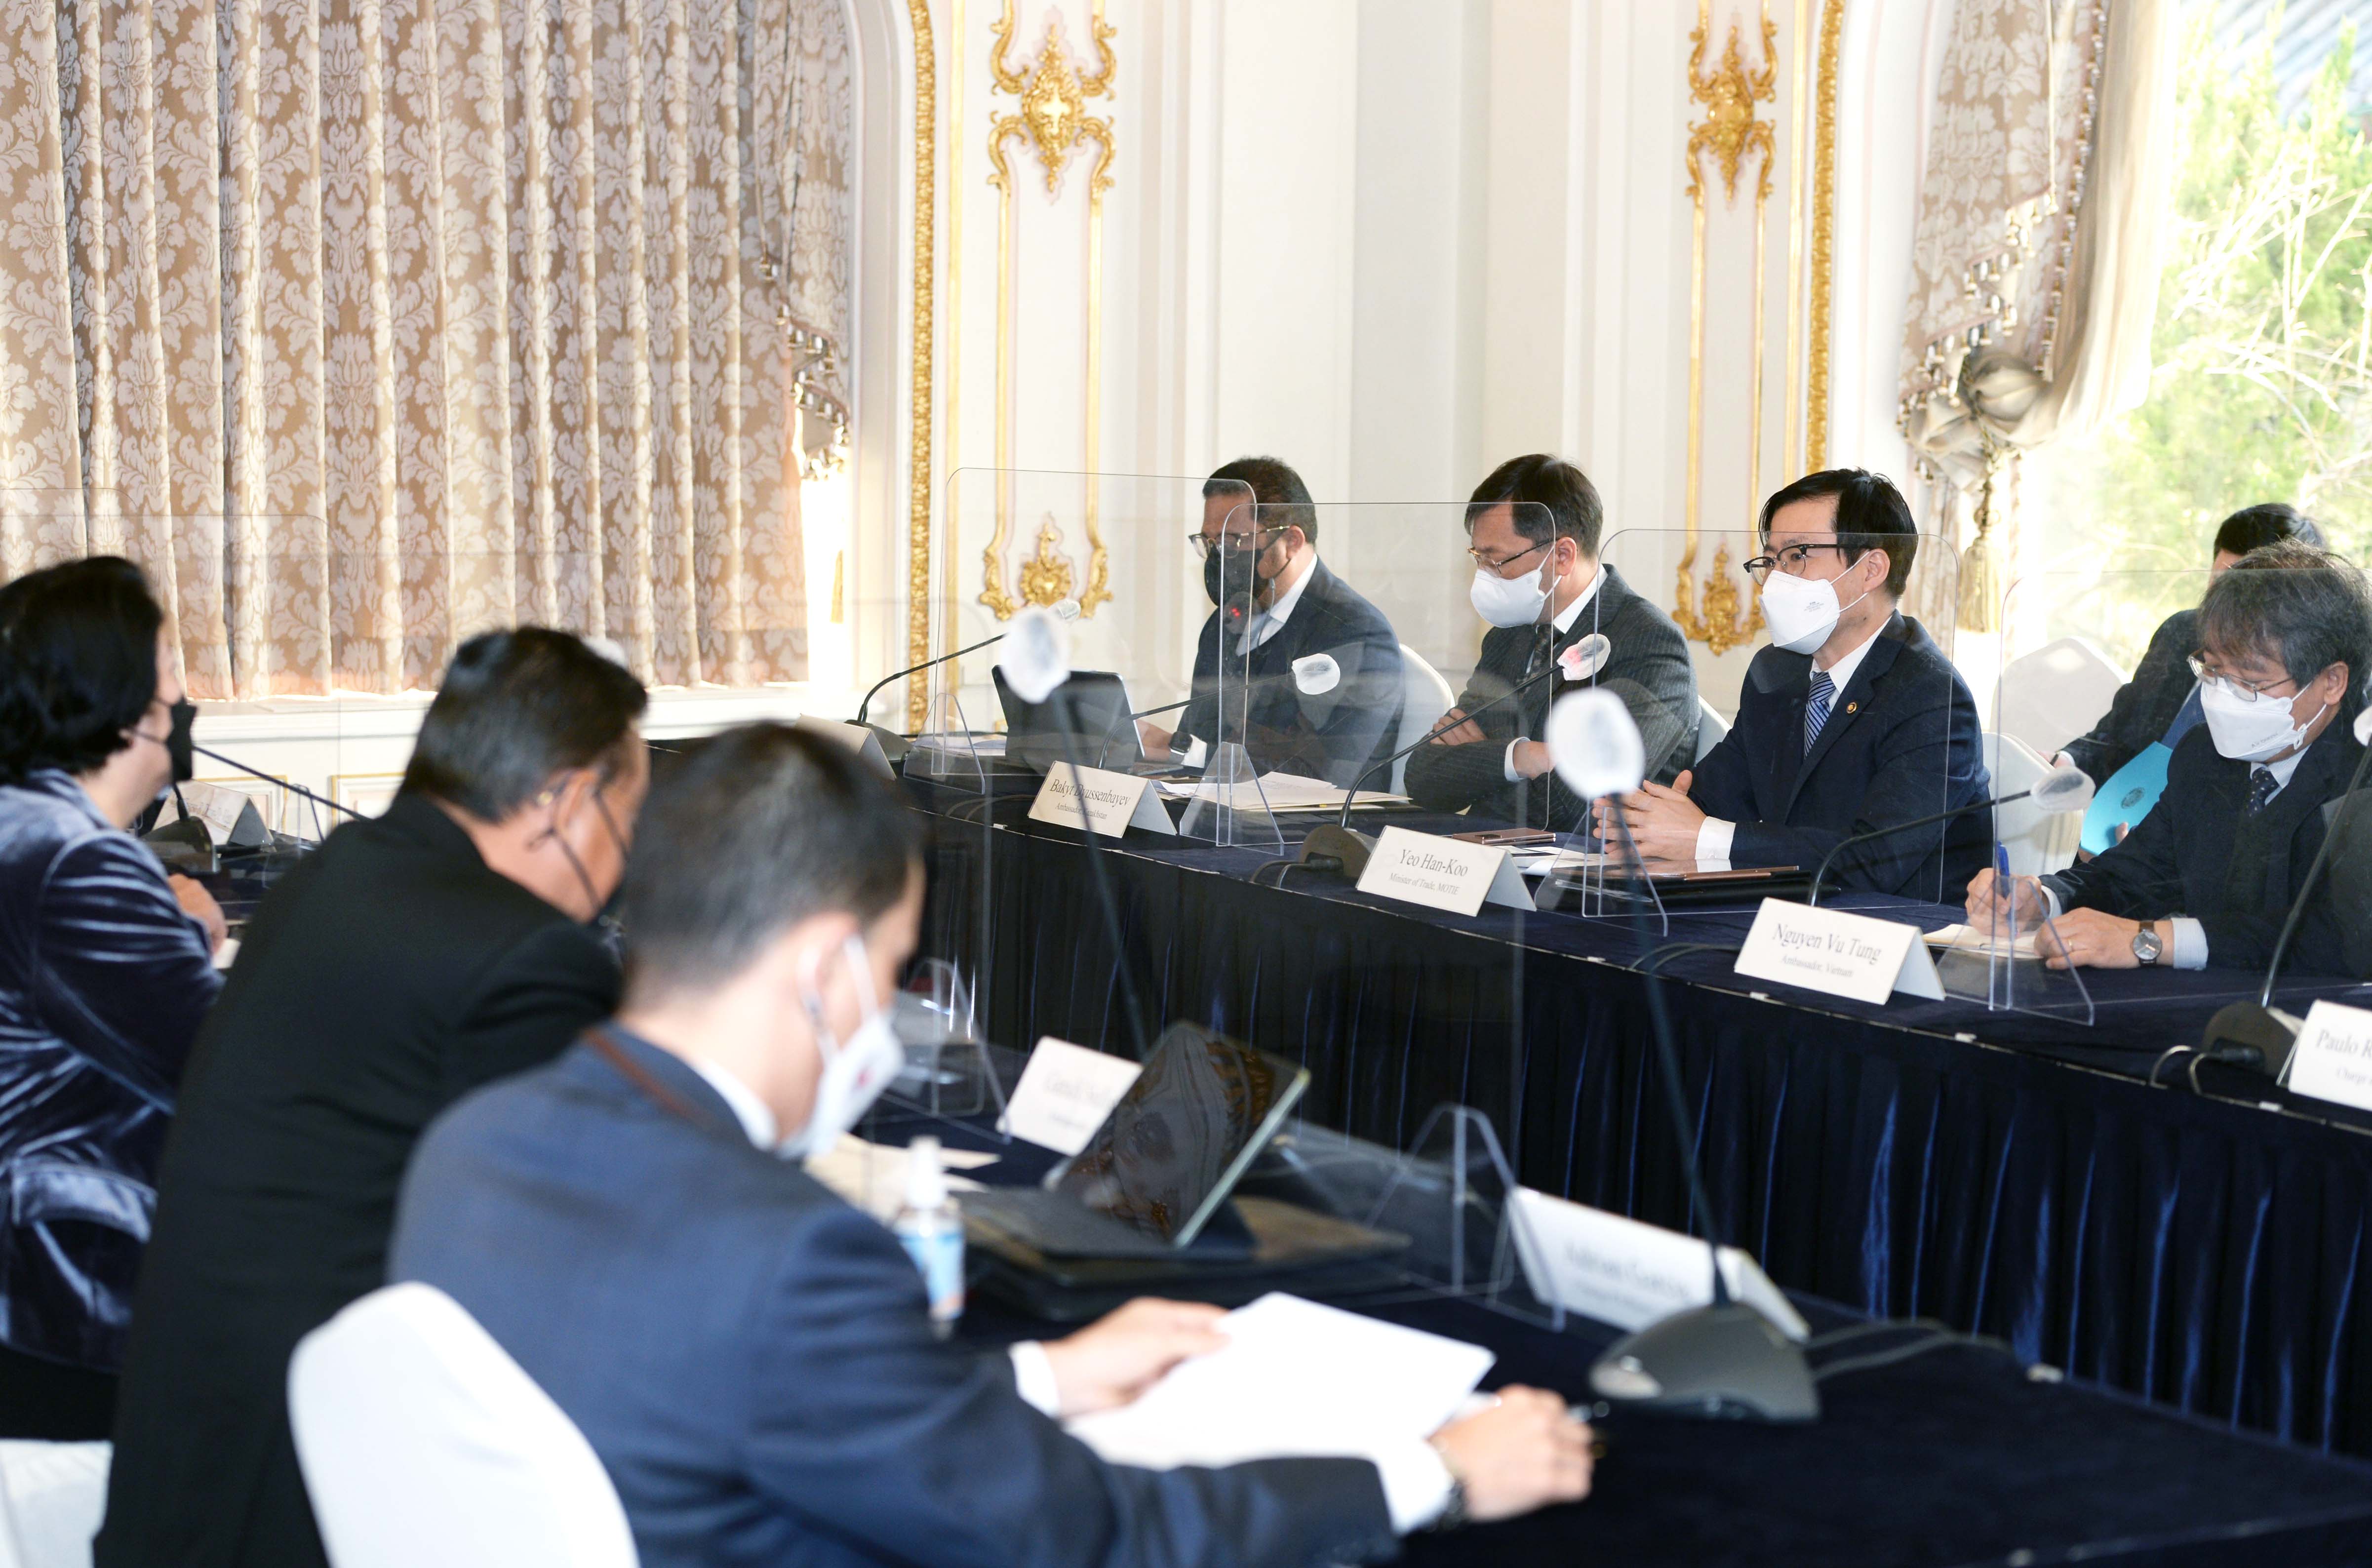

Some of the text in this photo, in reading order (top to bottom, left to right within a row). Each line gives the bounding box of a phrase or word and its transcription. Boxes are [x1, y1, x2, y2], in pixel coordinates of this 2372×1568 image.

[1050, 779, 1131, 808] Bakyt Dyussenbayev
[1400, 849, 1468, 877] Yeo Han-Koo
[1389, 872, 1460, 896] Minister of Trade, MOTIE
[1772, 923, 1882, 965] Nguyen Vu Tung
[2315, 1028, 2359, 1055] Paulo
